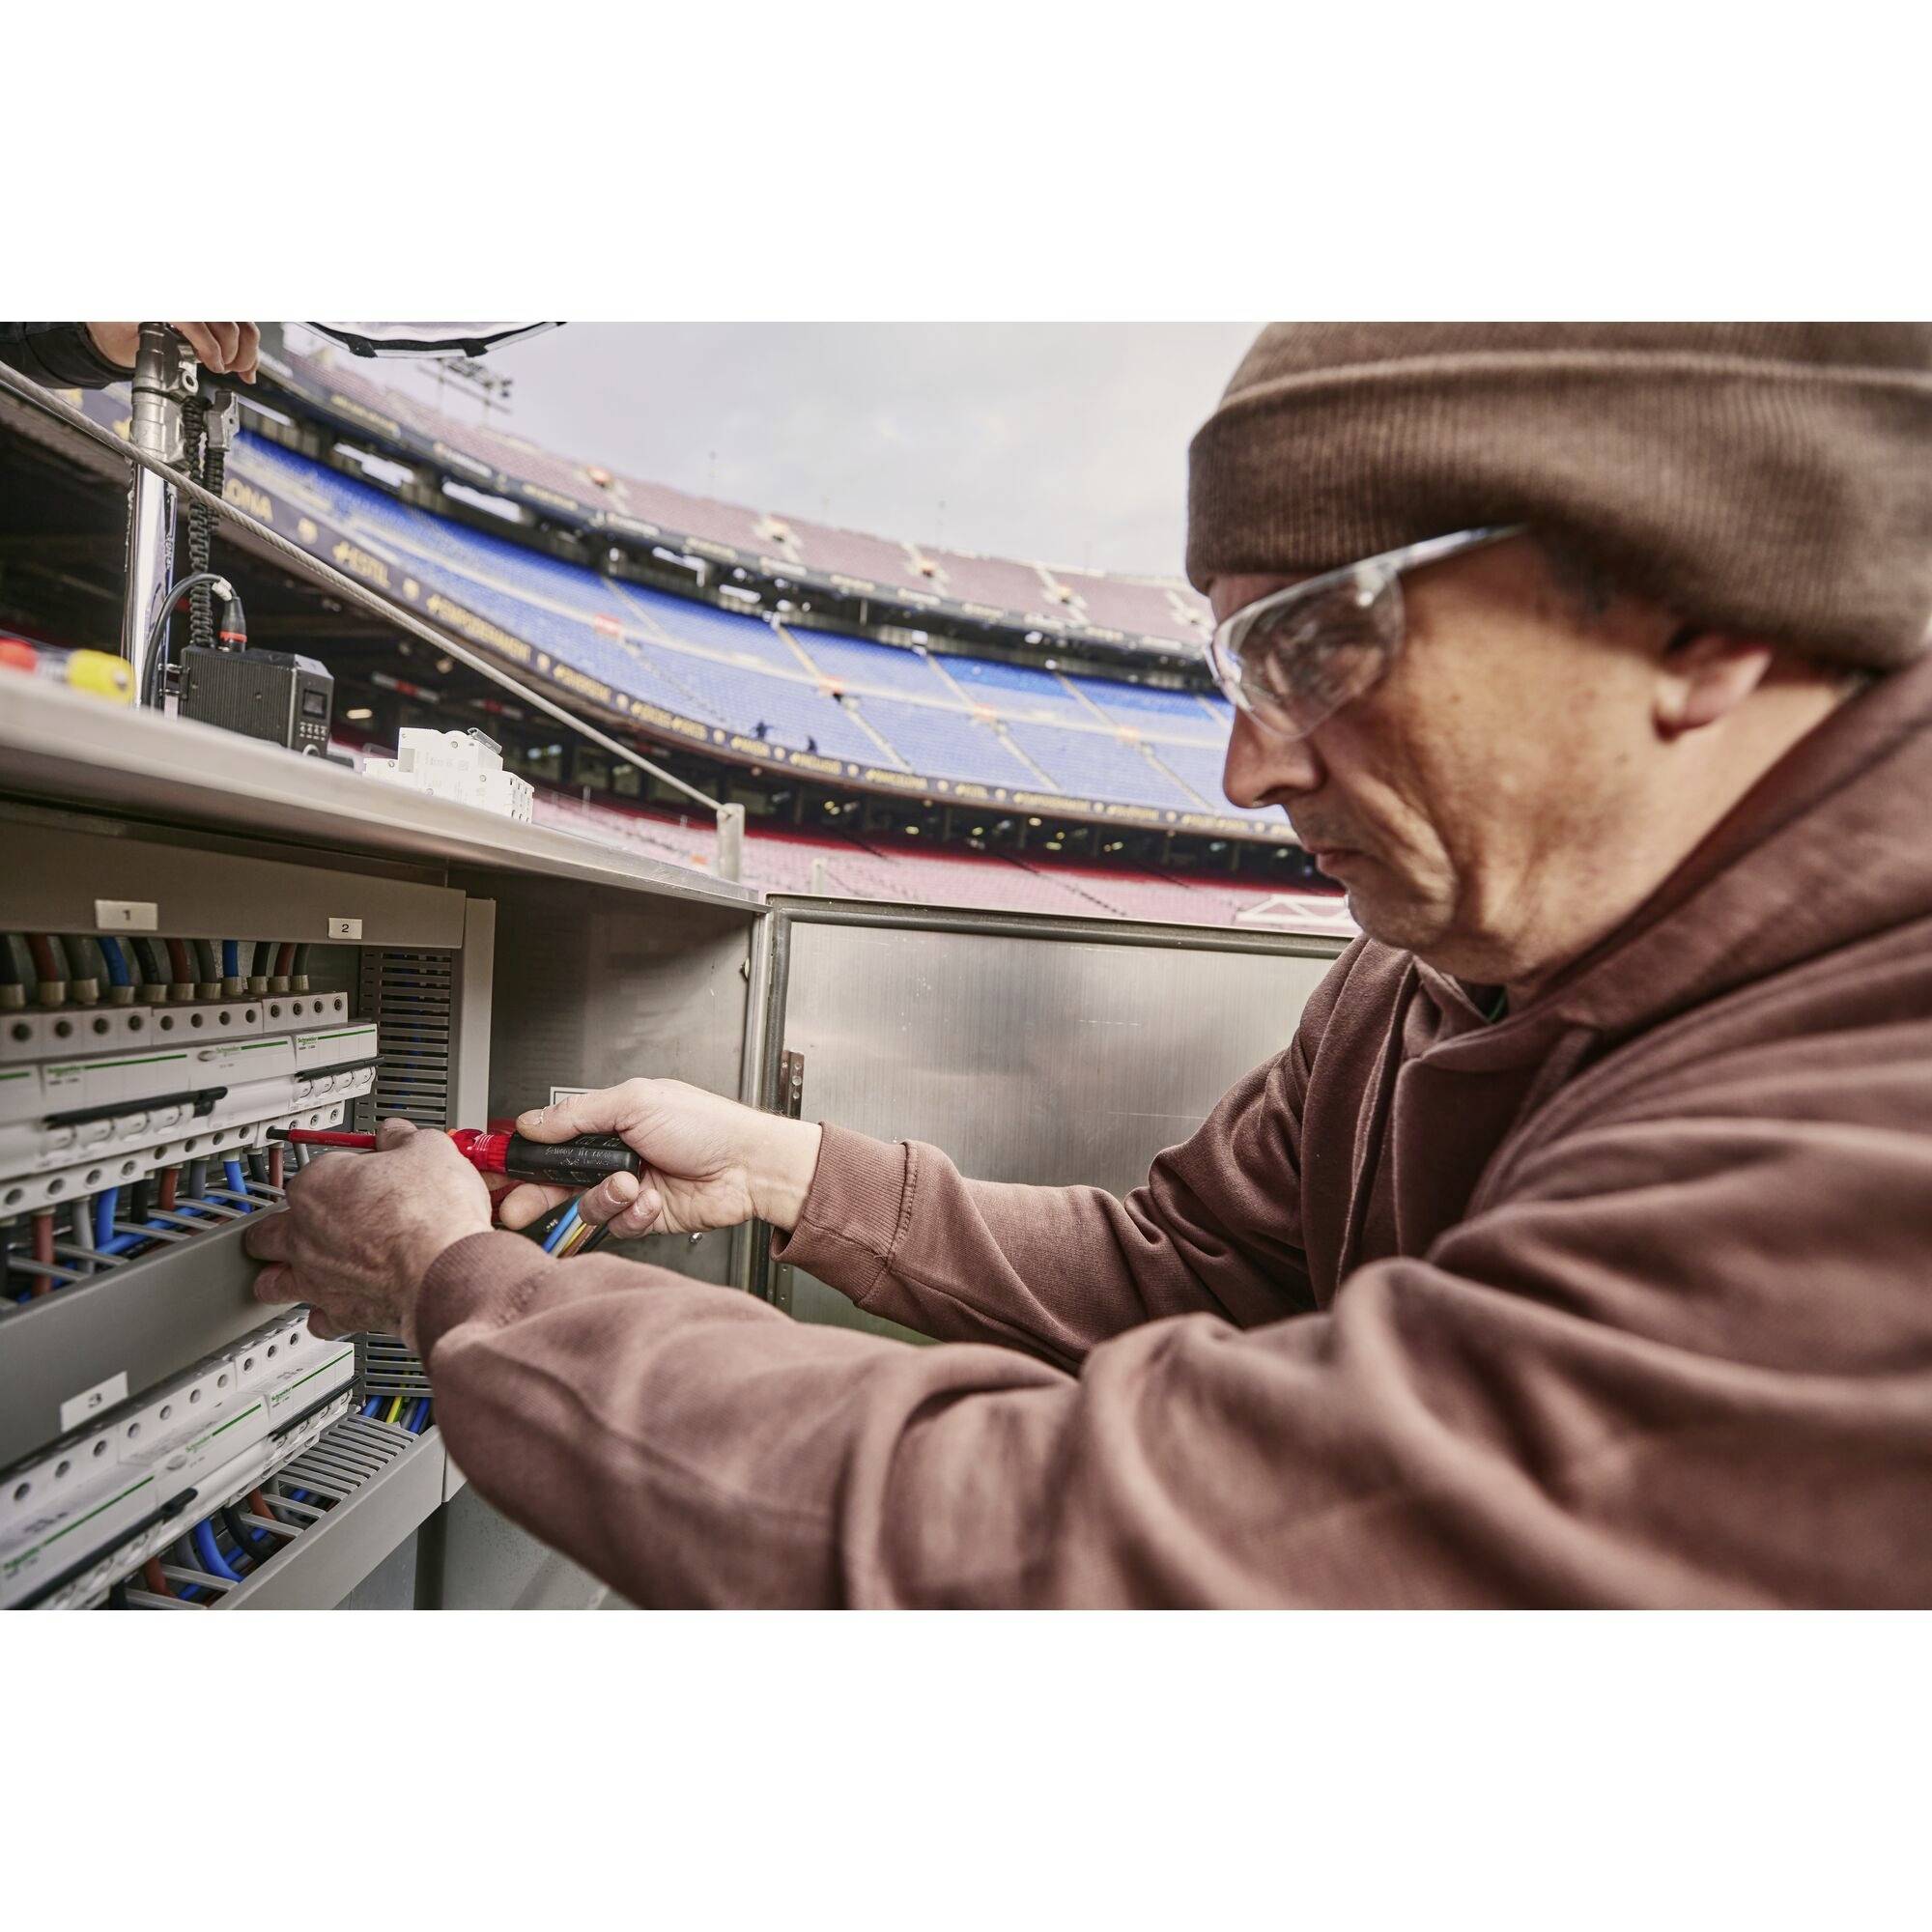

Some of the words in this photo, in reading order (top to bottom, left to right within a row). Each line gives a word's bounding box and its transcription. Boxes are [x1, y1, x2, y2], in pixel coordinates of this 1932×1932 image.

[122, 909, 131, 921] 1
[341, 923, 349, 933] 2
[88, 1392, 102, 1408] 3
